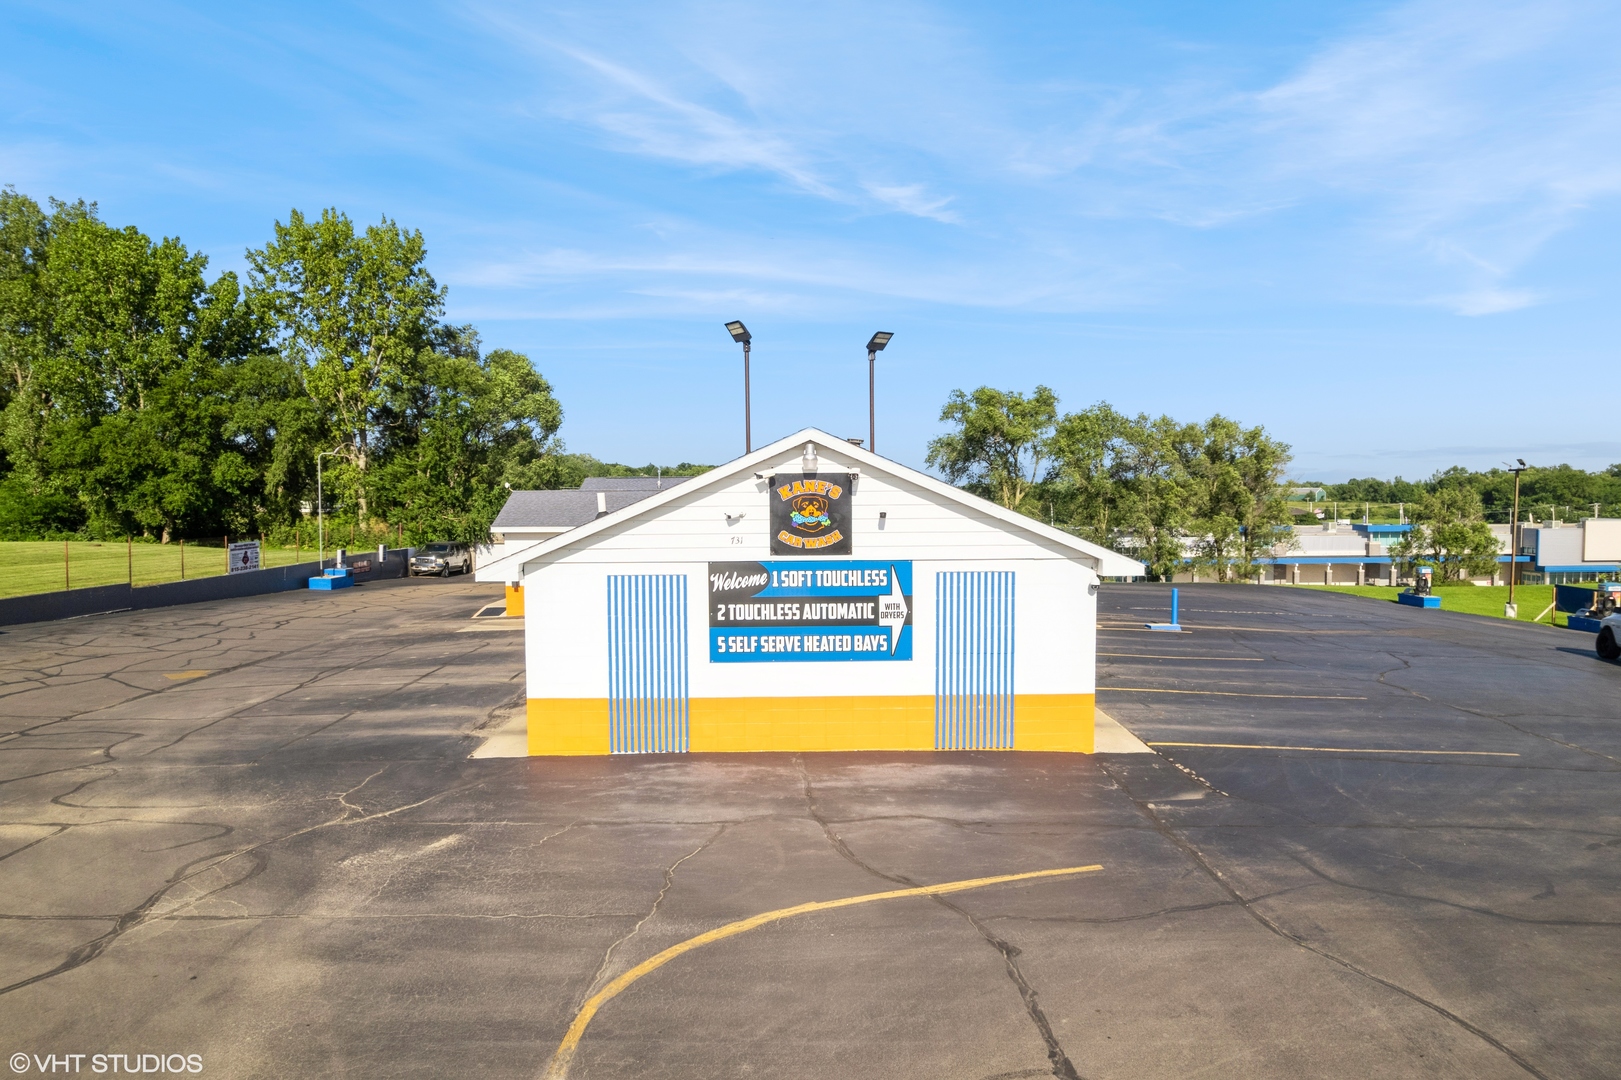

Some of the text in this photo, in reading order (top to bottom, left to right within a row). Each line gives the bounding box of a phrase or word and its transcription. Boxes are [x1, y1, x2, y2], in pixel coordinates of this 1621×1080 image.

[777, 480, 843, 501] KANE'S
[731, 536, 743, 545] 731
[778, 529, 843, 549] CAR WASH
[710, 571, 768, 592] Welcome
[772, 570, 888, 587] 1 SOFT TOUCHLESS
[717, 603, 875, 621] 2 TOUCHLESS AUTOMATIC
[880, 611, 905, 619] DRYERS
[884, 603, 900, 611] WITH
[717, 635, 888, 653] 5 SELF SERVE HEATED BAYS
